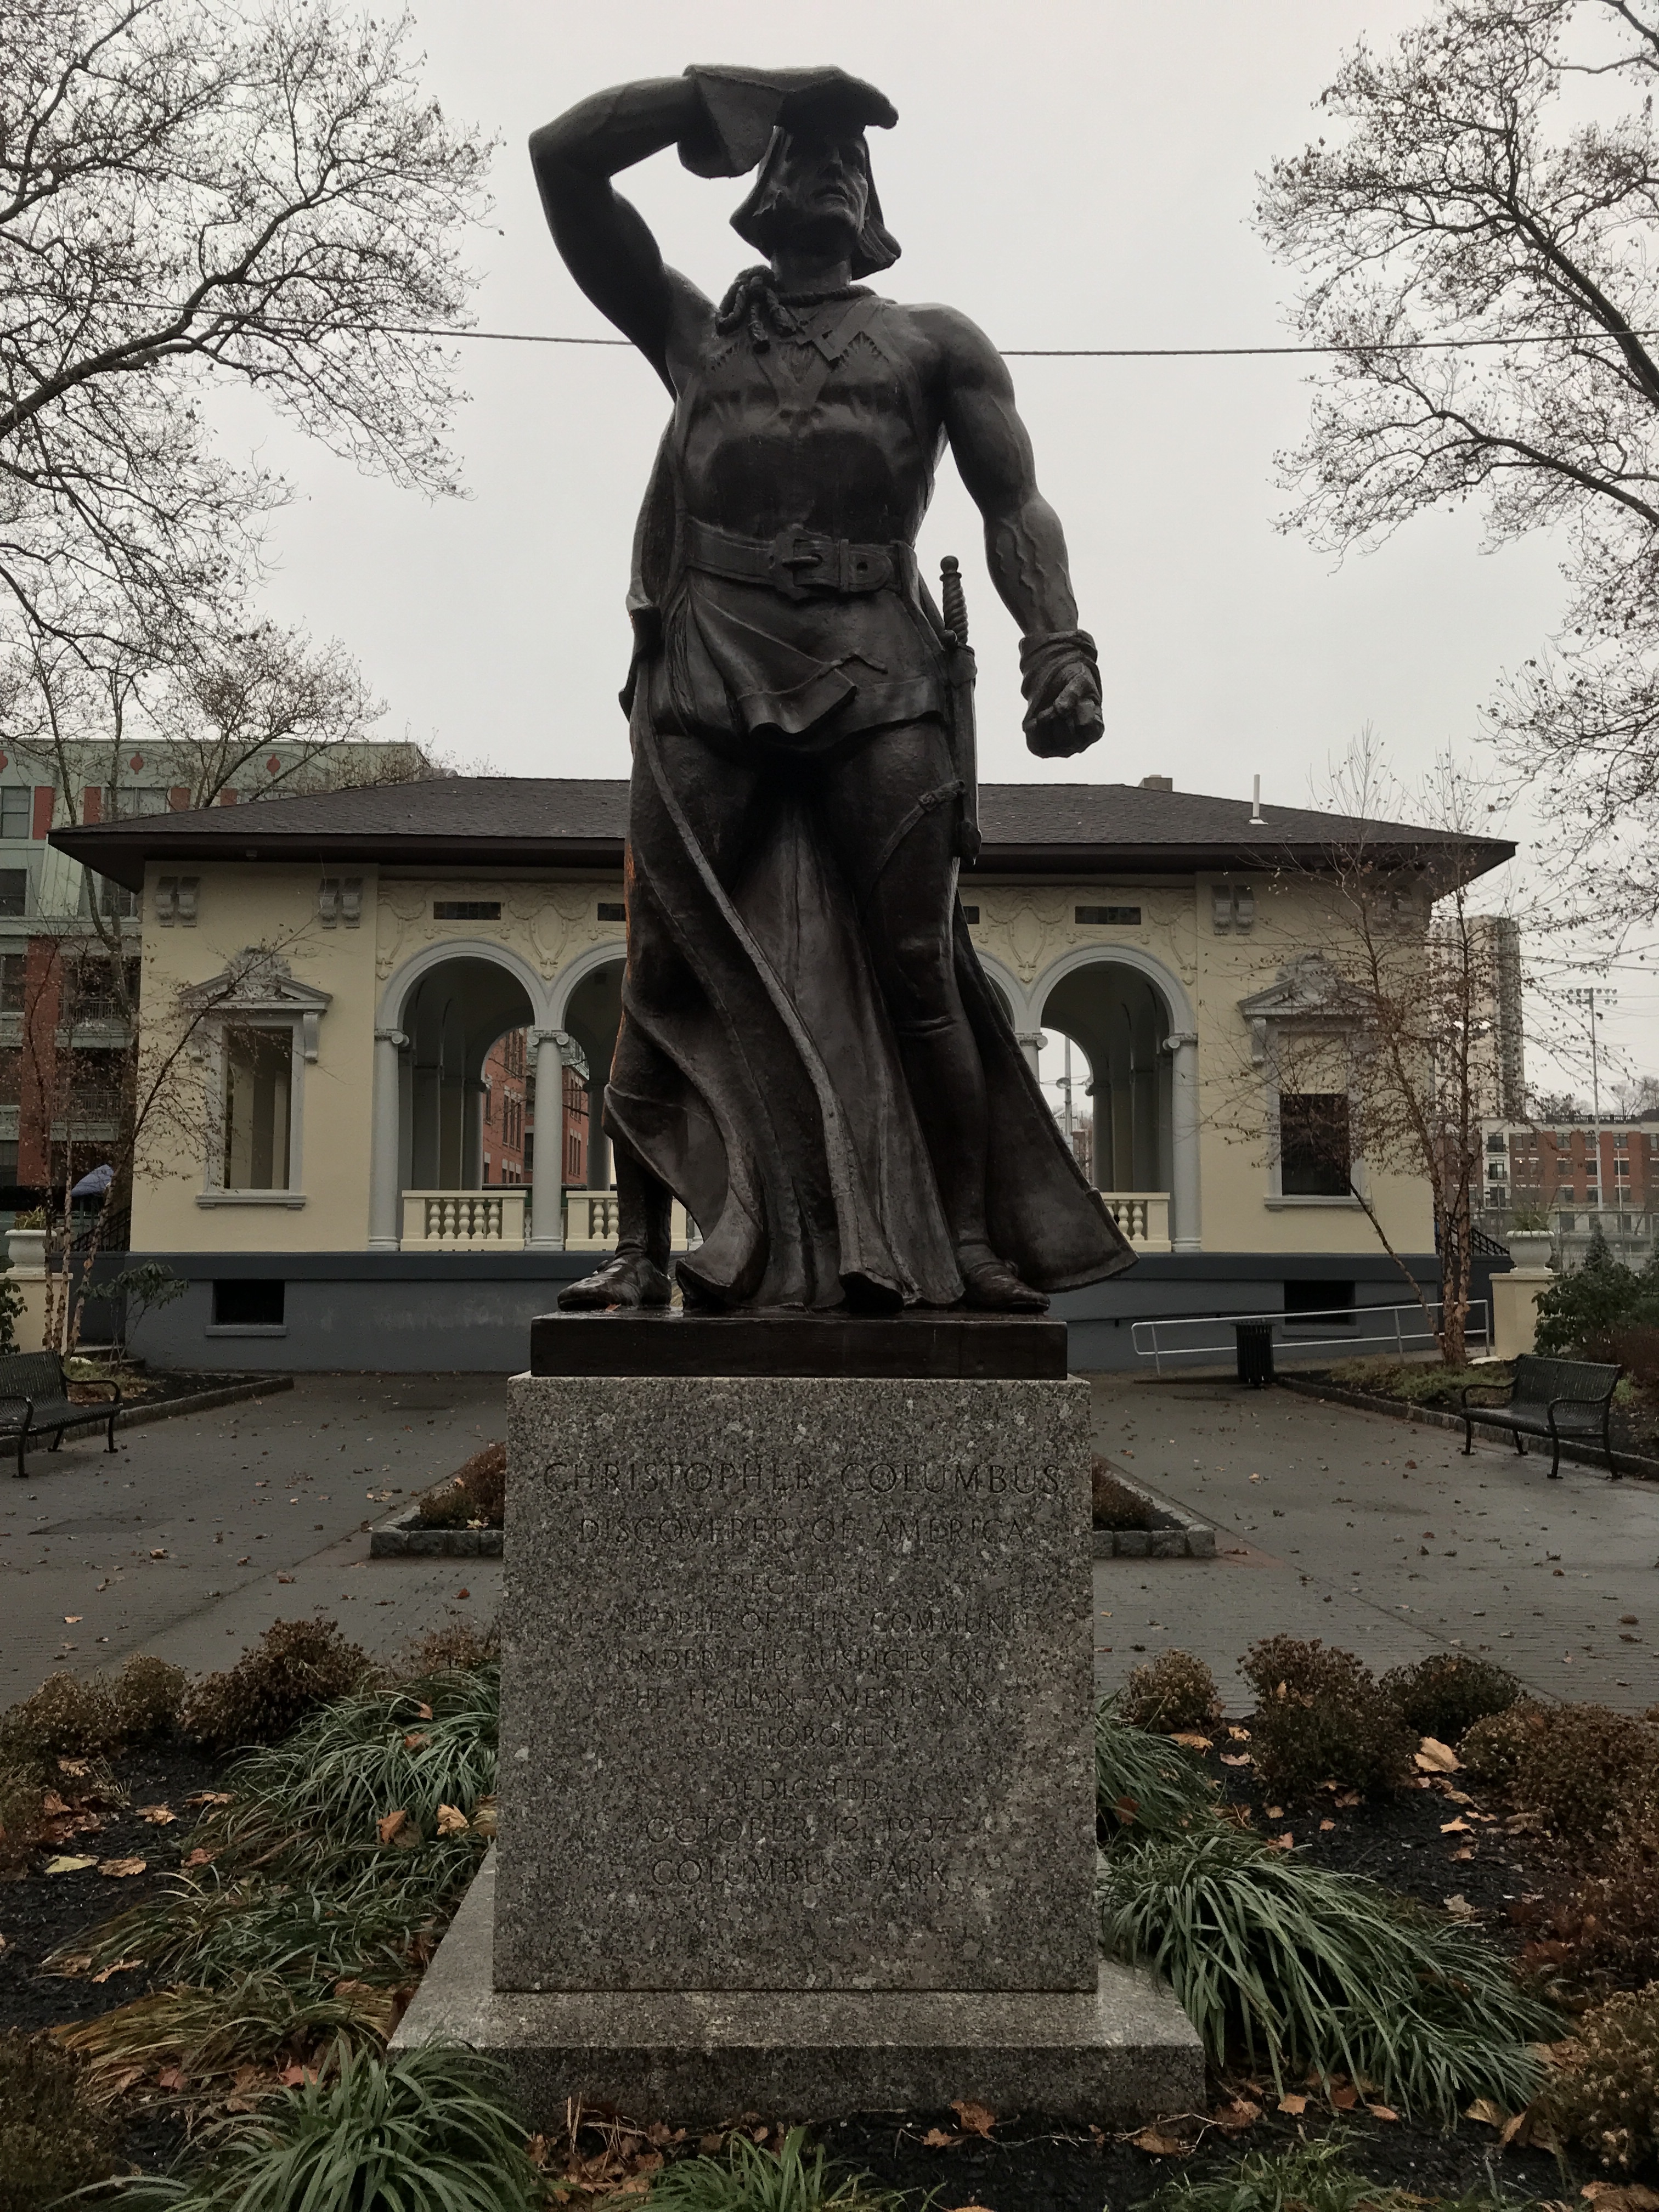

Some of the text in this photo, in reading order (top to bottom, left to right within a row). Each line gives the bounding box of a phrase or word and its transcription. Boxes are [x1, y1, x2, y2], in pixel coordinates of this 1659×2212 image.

[543, 1463, 1059, 1493] CHRISTOPHER COLUMBUS
[579, 1517, 1025, 1543] DISCOVERER OF AMERICA
[714, 1573, 887, 1594] ERECTED BY
[624, 1611, 721, 1633] PEOPLE
[741, 1611, 777, 1632] OF
[793, 1612, 853, 1633] THIS
[871, 1612, 1047, 1634] COMMUNITY
[618, 1648, 990, 1672] UNDER THE AUSPICES OF
[622, 1687, 667, 1709] THE
[701, 1726, 899, 1747] OF HOBOKEN
[721, 1778, 878, 1800] DEDICATED
[646, 1816, 811, 1842] OCTOBER
[887, 1816, 953, 1843] 1937
[653, 1859, 945, 1885] COLUMBUS PARK
